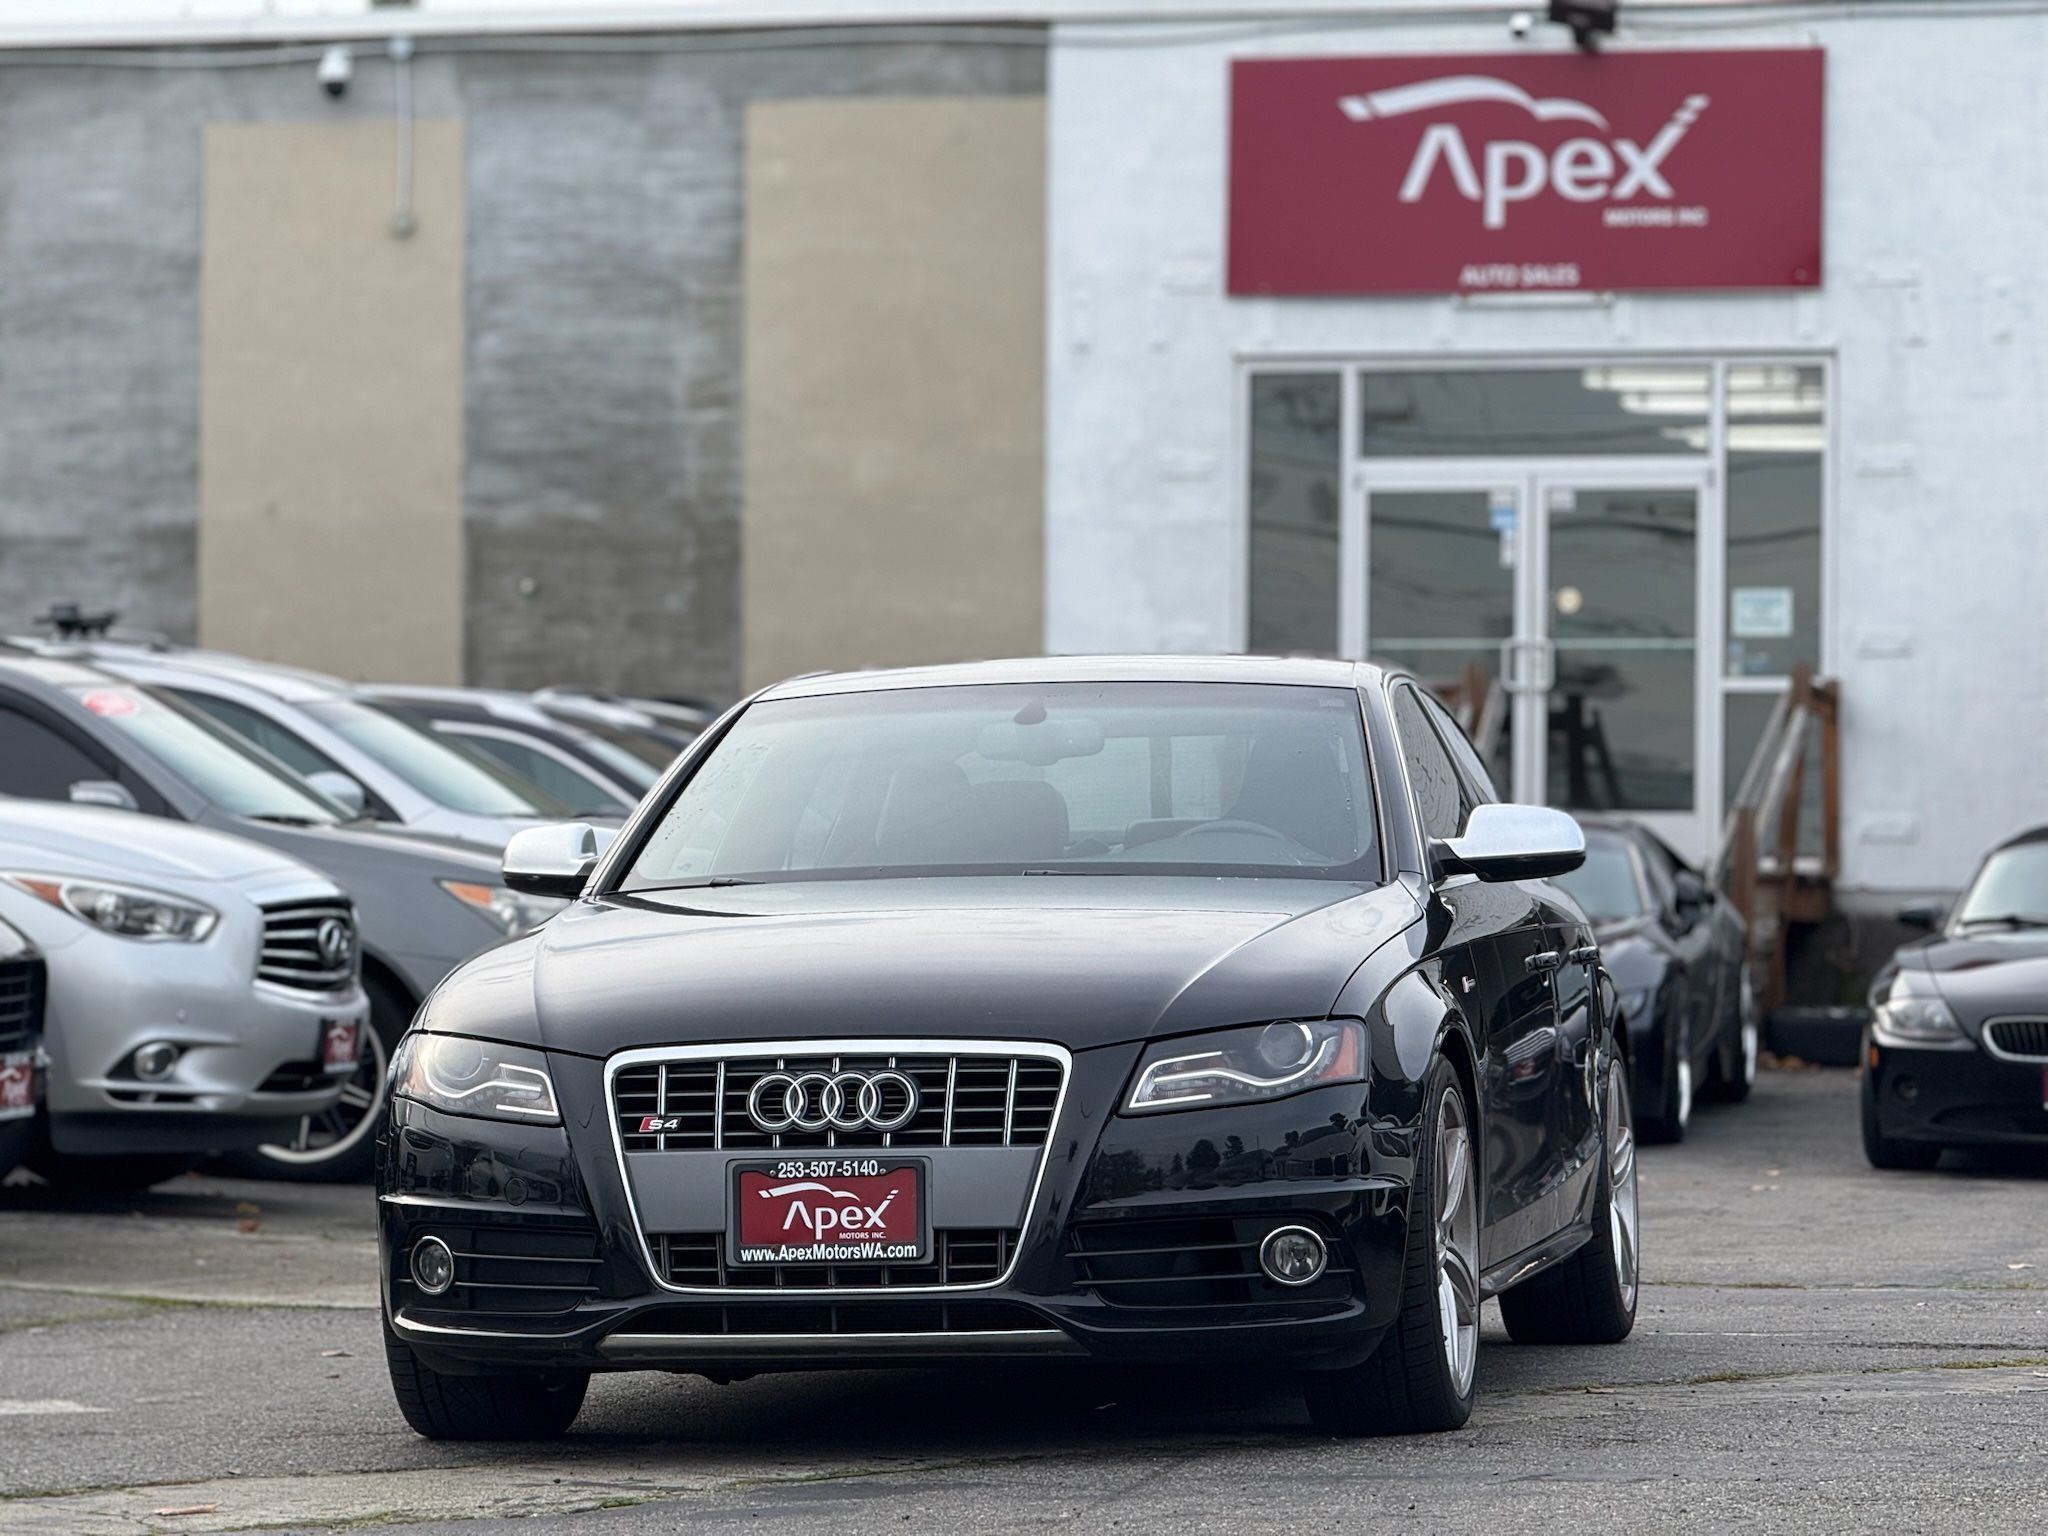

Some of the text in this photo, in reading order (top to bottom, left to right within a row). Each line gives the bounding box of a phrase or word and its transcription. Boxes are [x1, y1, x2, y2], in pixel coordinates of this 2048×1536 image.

[1399, 95, 1710, 228] Apex
[1603, 206, 1673, 227] MOTORS
[1459, 262, 1580, 287] AUTO SALES
[648, 1119, 679, 1130] S4
[778, 1160, 878, 1178] 253-507-5140
[782, 1189, 899, 1240] Apex
[839, 1231, 887, 1239] MOTORS INC.
[741, 1243, 917, 1261] www.ApexMotorsWA.com
